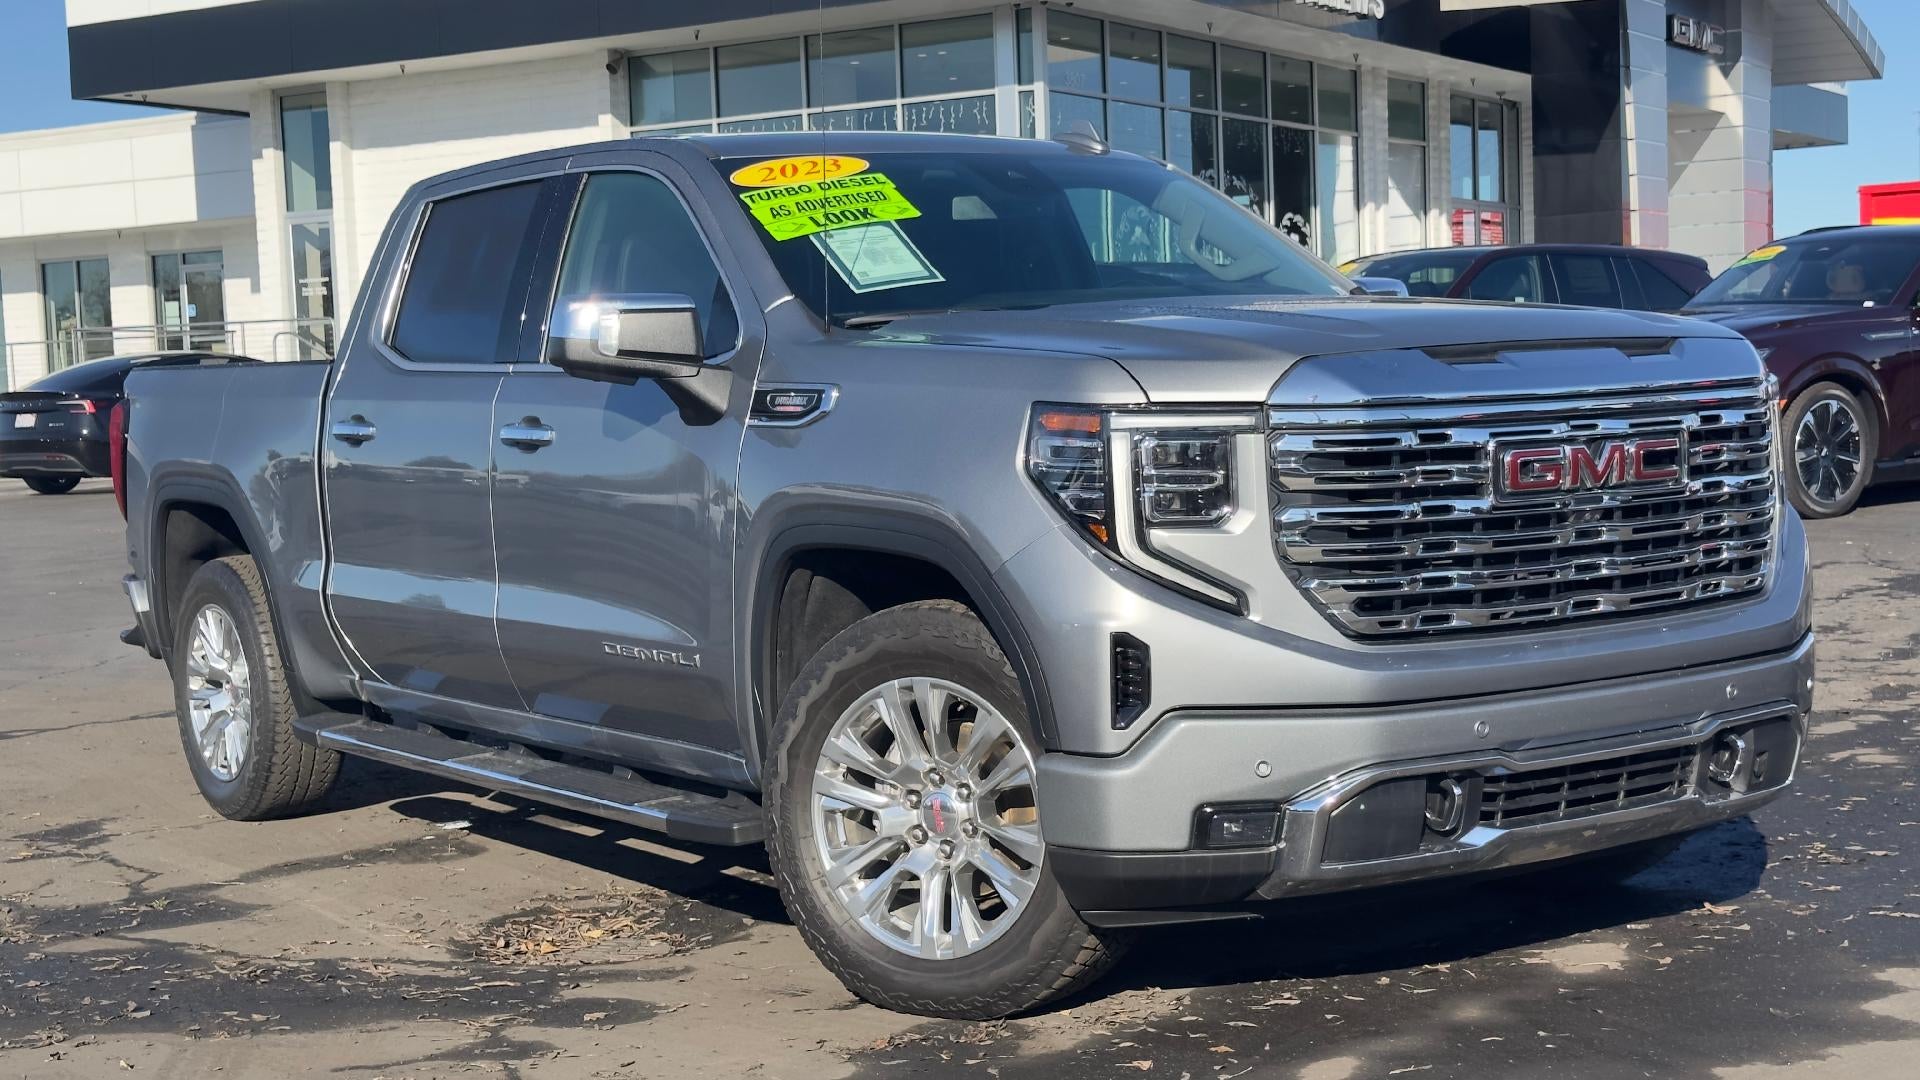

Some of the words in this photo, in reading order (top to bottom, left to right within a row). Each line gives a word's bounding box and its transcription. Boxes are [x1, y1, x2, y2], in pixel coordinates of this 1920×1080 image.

[1673, 15, 1725, 55] GMC
[759, 158, 843, 183] 2023
[744, 183, 813, 205] TURBO
[818, 175, 888, 191] DIESEL
[769, 204, 793, 220] AS
[794, 189, 888, 214] ADVERTISED
[808, 206, 878, 228] LOOK
[1504, 438, 1681, 492] GMC
[601, 640, 701, 669] DENALI
